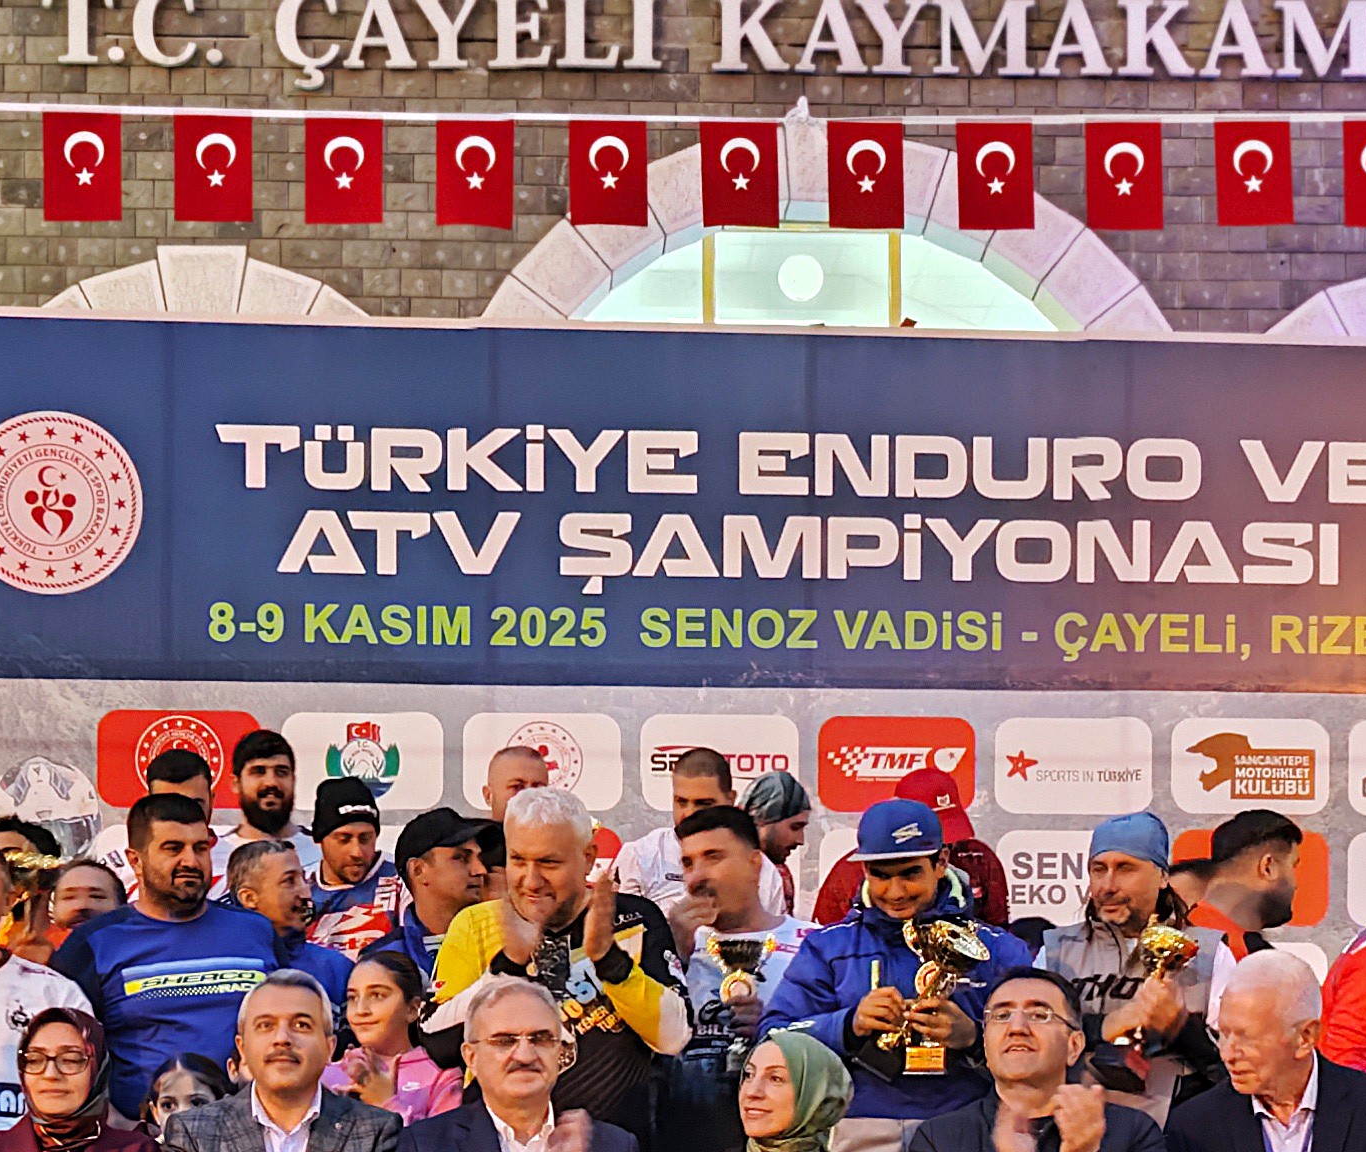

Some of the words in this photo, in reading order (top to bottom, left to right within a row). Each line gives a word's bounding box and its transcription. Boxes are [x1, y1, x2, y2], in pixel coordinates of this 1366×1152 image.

[35, 447, 80, 465] GENÇLİK
[81, 461, 93, 476] VE
[90, 475, 105, 505] SPOR
[739, 431, 1202, 501] ENDURO
[276, 509, 522, 576] ATV
[208, 602, 285, 643] 8-9
[304, 603, 471, 646] KASIM
[490, 606, 607, 648] 2025
[639, 607, 819, 650] SENOZ
[870, 752, 924, 770] TMF
[1234, 755, 1310, 767] SANCAKTEPE
[1035, 768, 1079, 782] SPORTS
[1083, 769, 1094, 782] IN
[1234, 779, 1311, 796] KULÜBÜ
[1011, 852, 1084, 880] SEN
[1010, 884, 1067, 905] EKO
[141, 971, 256, 988] SHERCO
[1071, 973, 1147, 1001] THO
